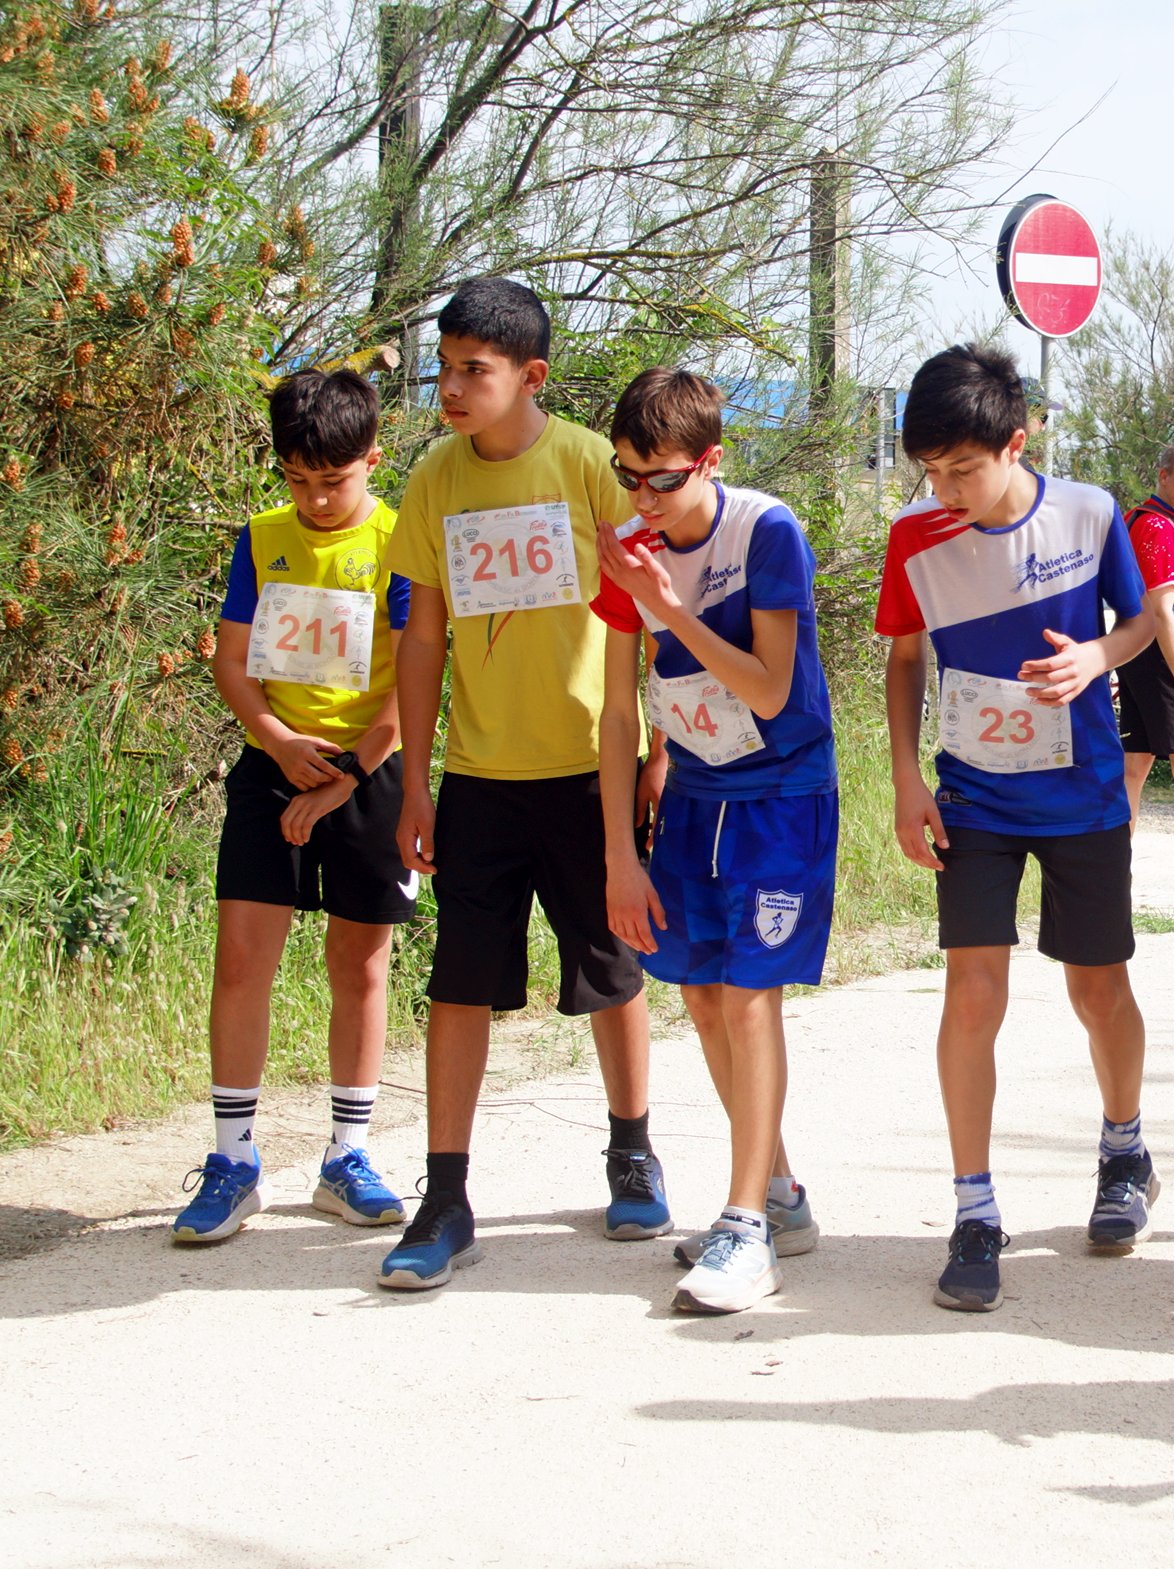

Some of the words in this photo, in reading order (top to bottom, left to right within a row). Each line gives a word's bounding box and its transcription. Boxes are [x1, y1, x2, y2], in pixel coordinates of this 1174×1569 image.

[469, 535, 554, 582] 216
[1037, 554, 1094, 583] Castenaso
[1038, 548, 1083, 572] Atletica
[275, 613, 349, 657] 211
[670, 703, 719, 737] 14
[978, 706, 1035, 744] 23
[760, 902, 798, 911] Castenaso
[765, 897, 795, 905] Atletica
